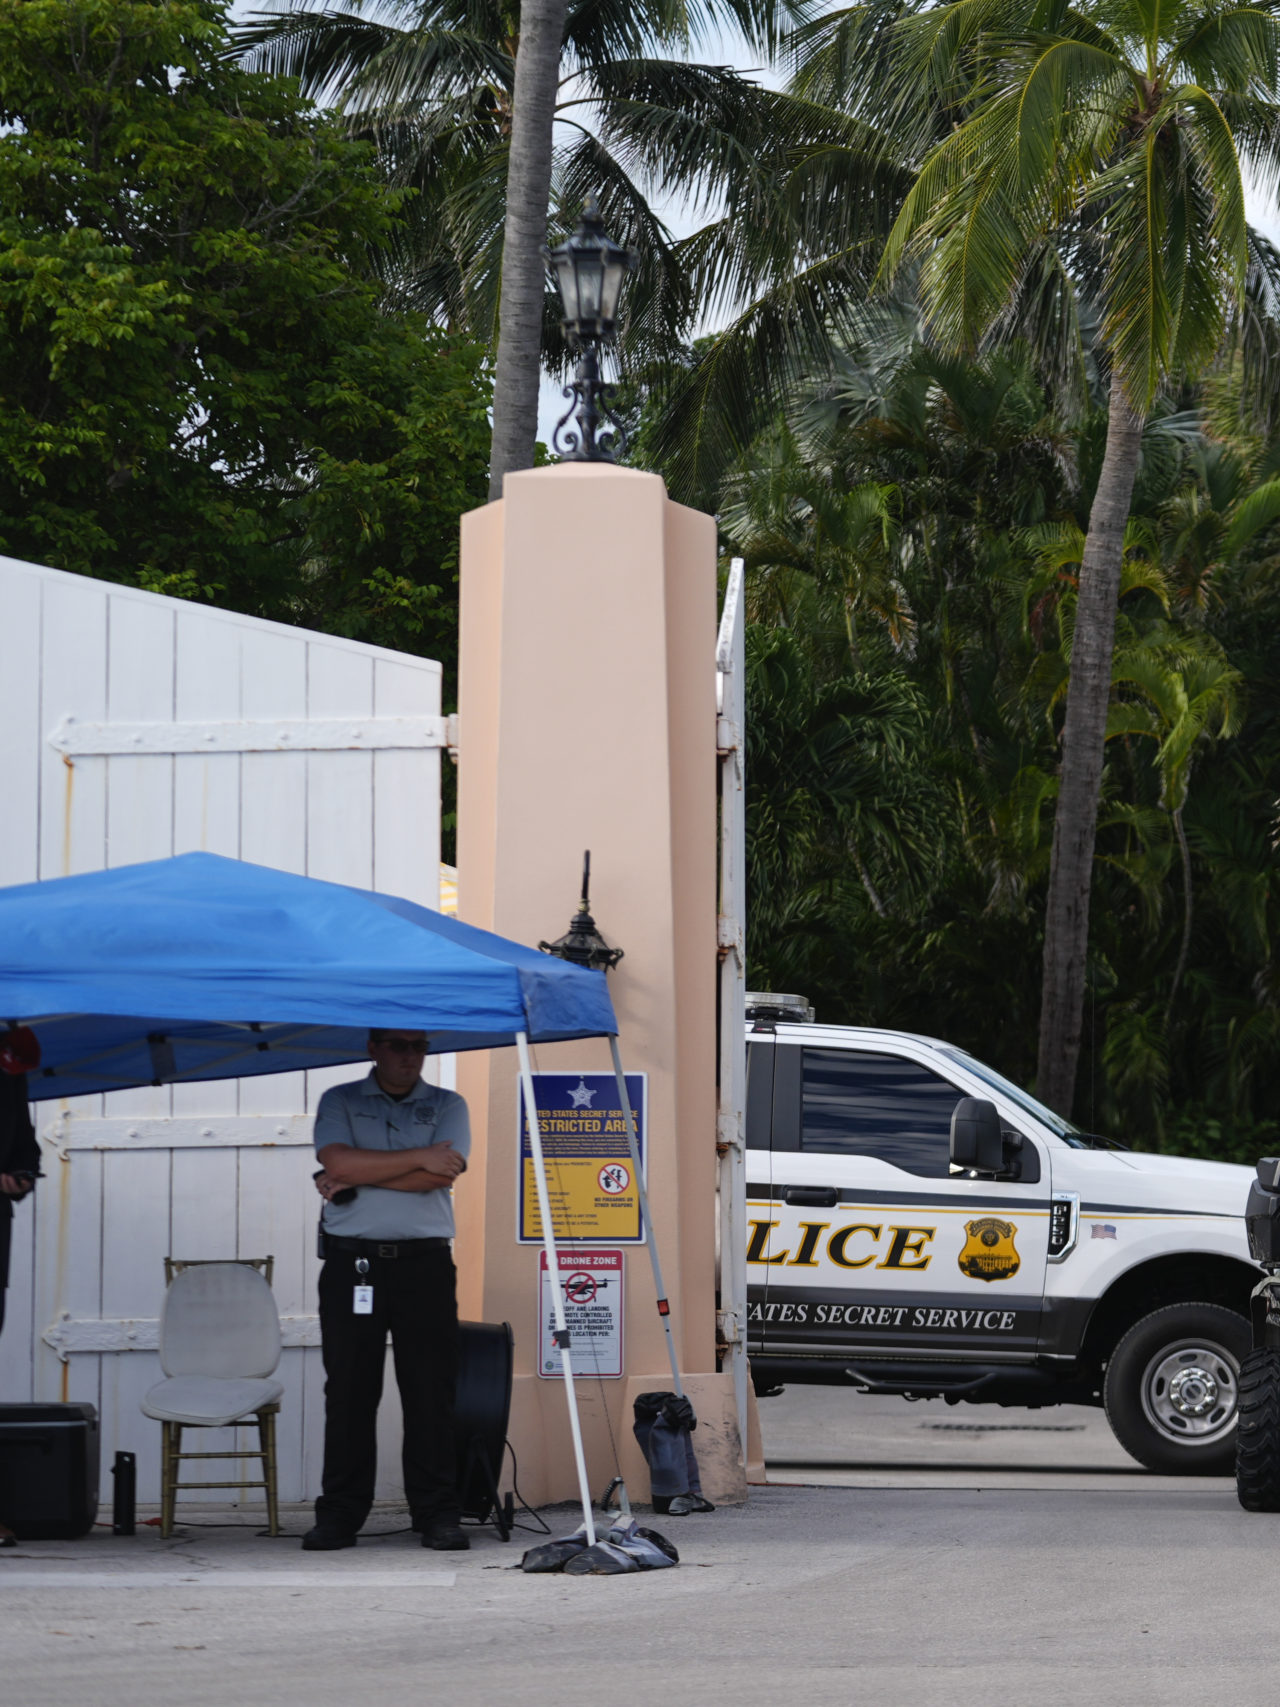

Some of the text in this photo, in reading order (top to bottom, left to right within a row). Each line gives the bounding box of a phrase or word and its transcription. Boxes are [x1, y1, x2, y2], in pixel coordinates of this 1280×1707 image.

[552, 1110, 579, 1118] STATES
[580, 1110, 607, 1118] SECRET
[747, 1220, 937, 1271] LICE
[560, 1256, 591, 1265] DRONE
[593, 1256, 617, 1265] ZONE
[747, 1302, 1017, 1330] ATES SECRET SERVICE
